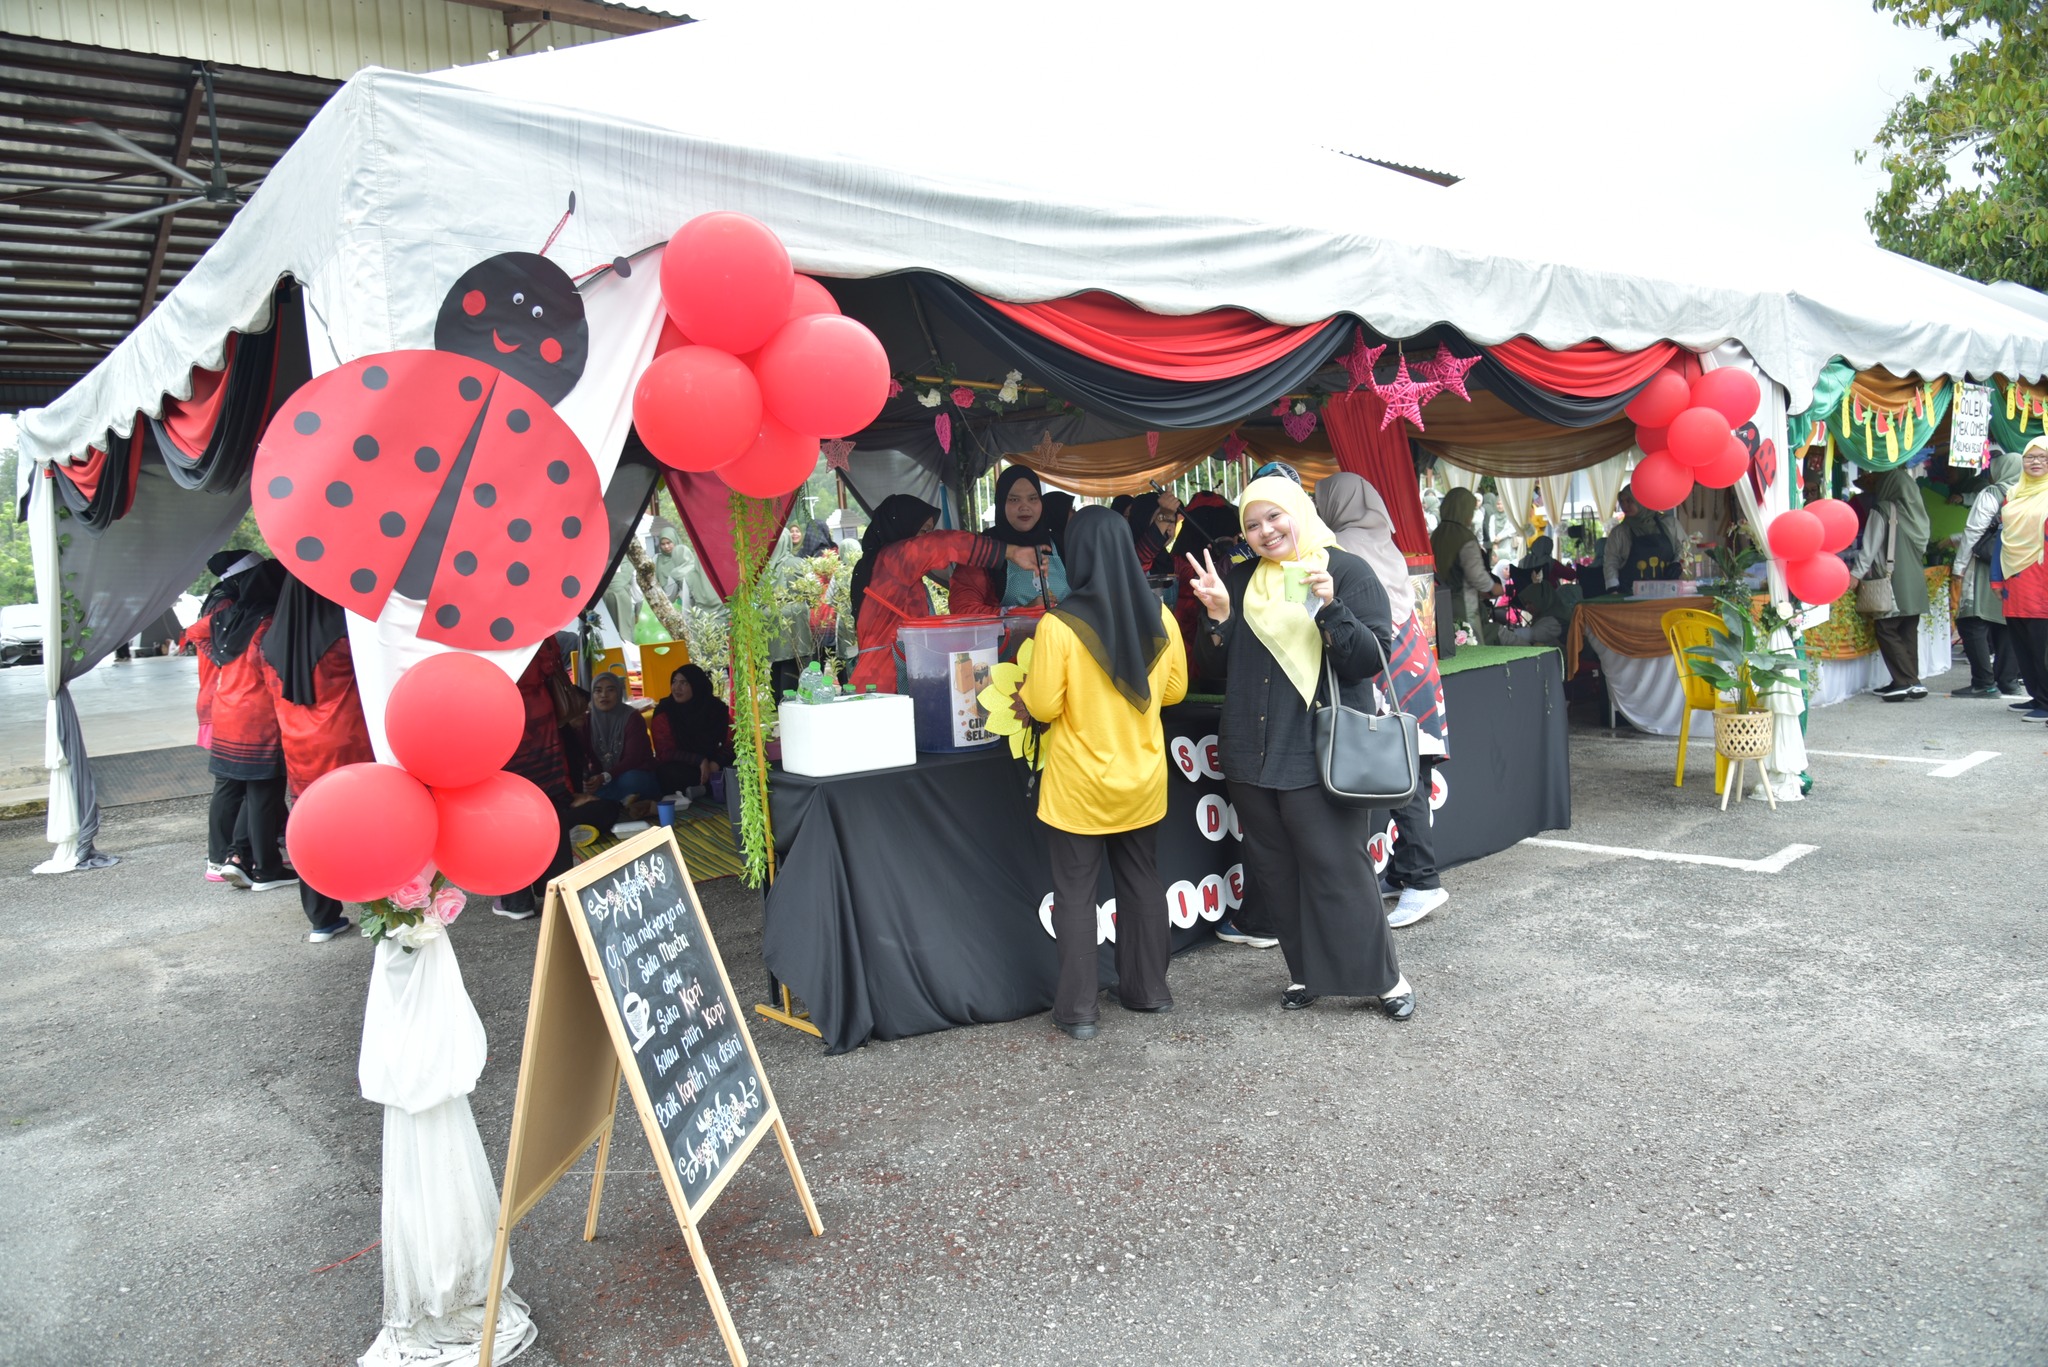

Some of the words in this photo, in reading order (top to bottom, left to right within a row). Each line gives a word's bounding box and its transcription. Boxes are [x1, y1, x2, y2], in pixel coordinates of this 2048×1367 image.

[1960, 397, 1983, 418] COLEK
[1970, 421, 1987, 437] COMEL
[622, 932, 639, 959] aku
[637, 918, 656, 944] nak
[652, 907, 677, 935] tanya
[675, 897, 687, 916] ni
[637, 952, 661, 984] Suka
[662, 969, 683, 995] atau
[656, 1004, 681, 1035] Suka
[678, 977, 704, 1018] Kopi
[680, 1024, 704, 1058] pilih
[655, 1092, 682, 1128] Baik
[718, 1032, 743, 1063] disini
